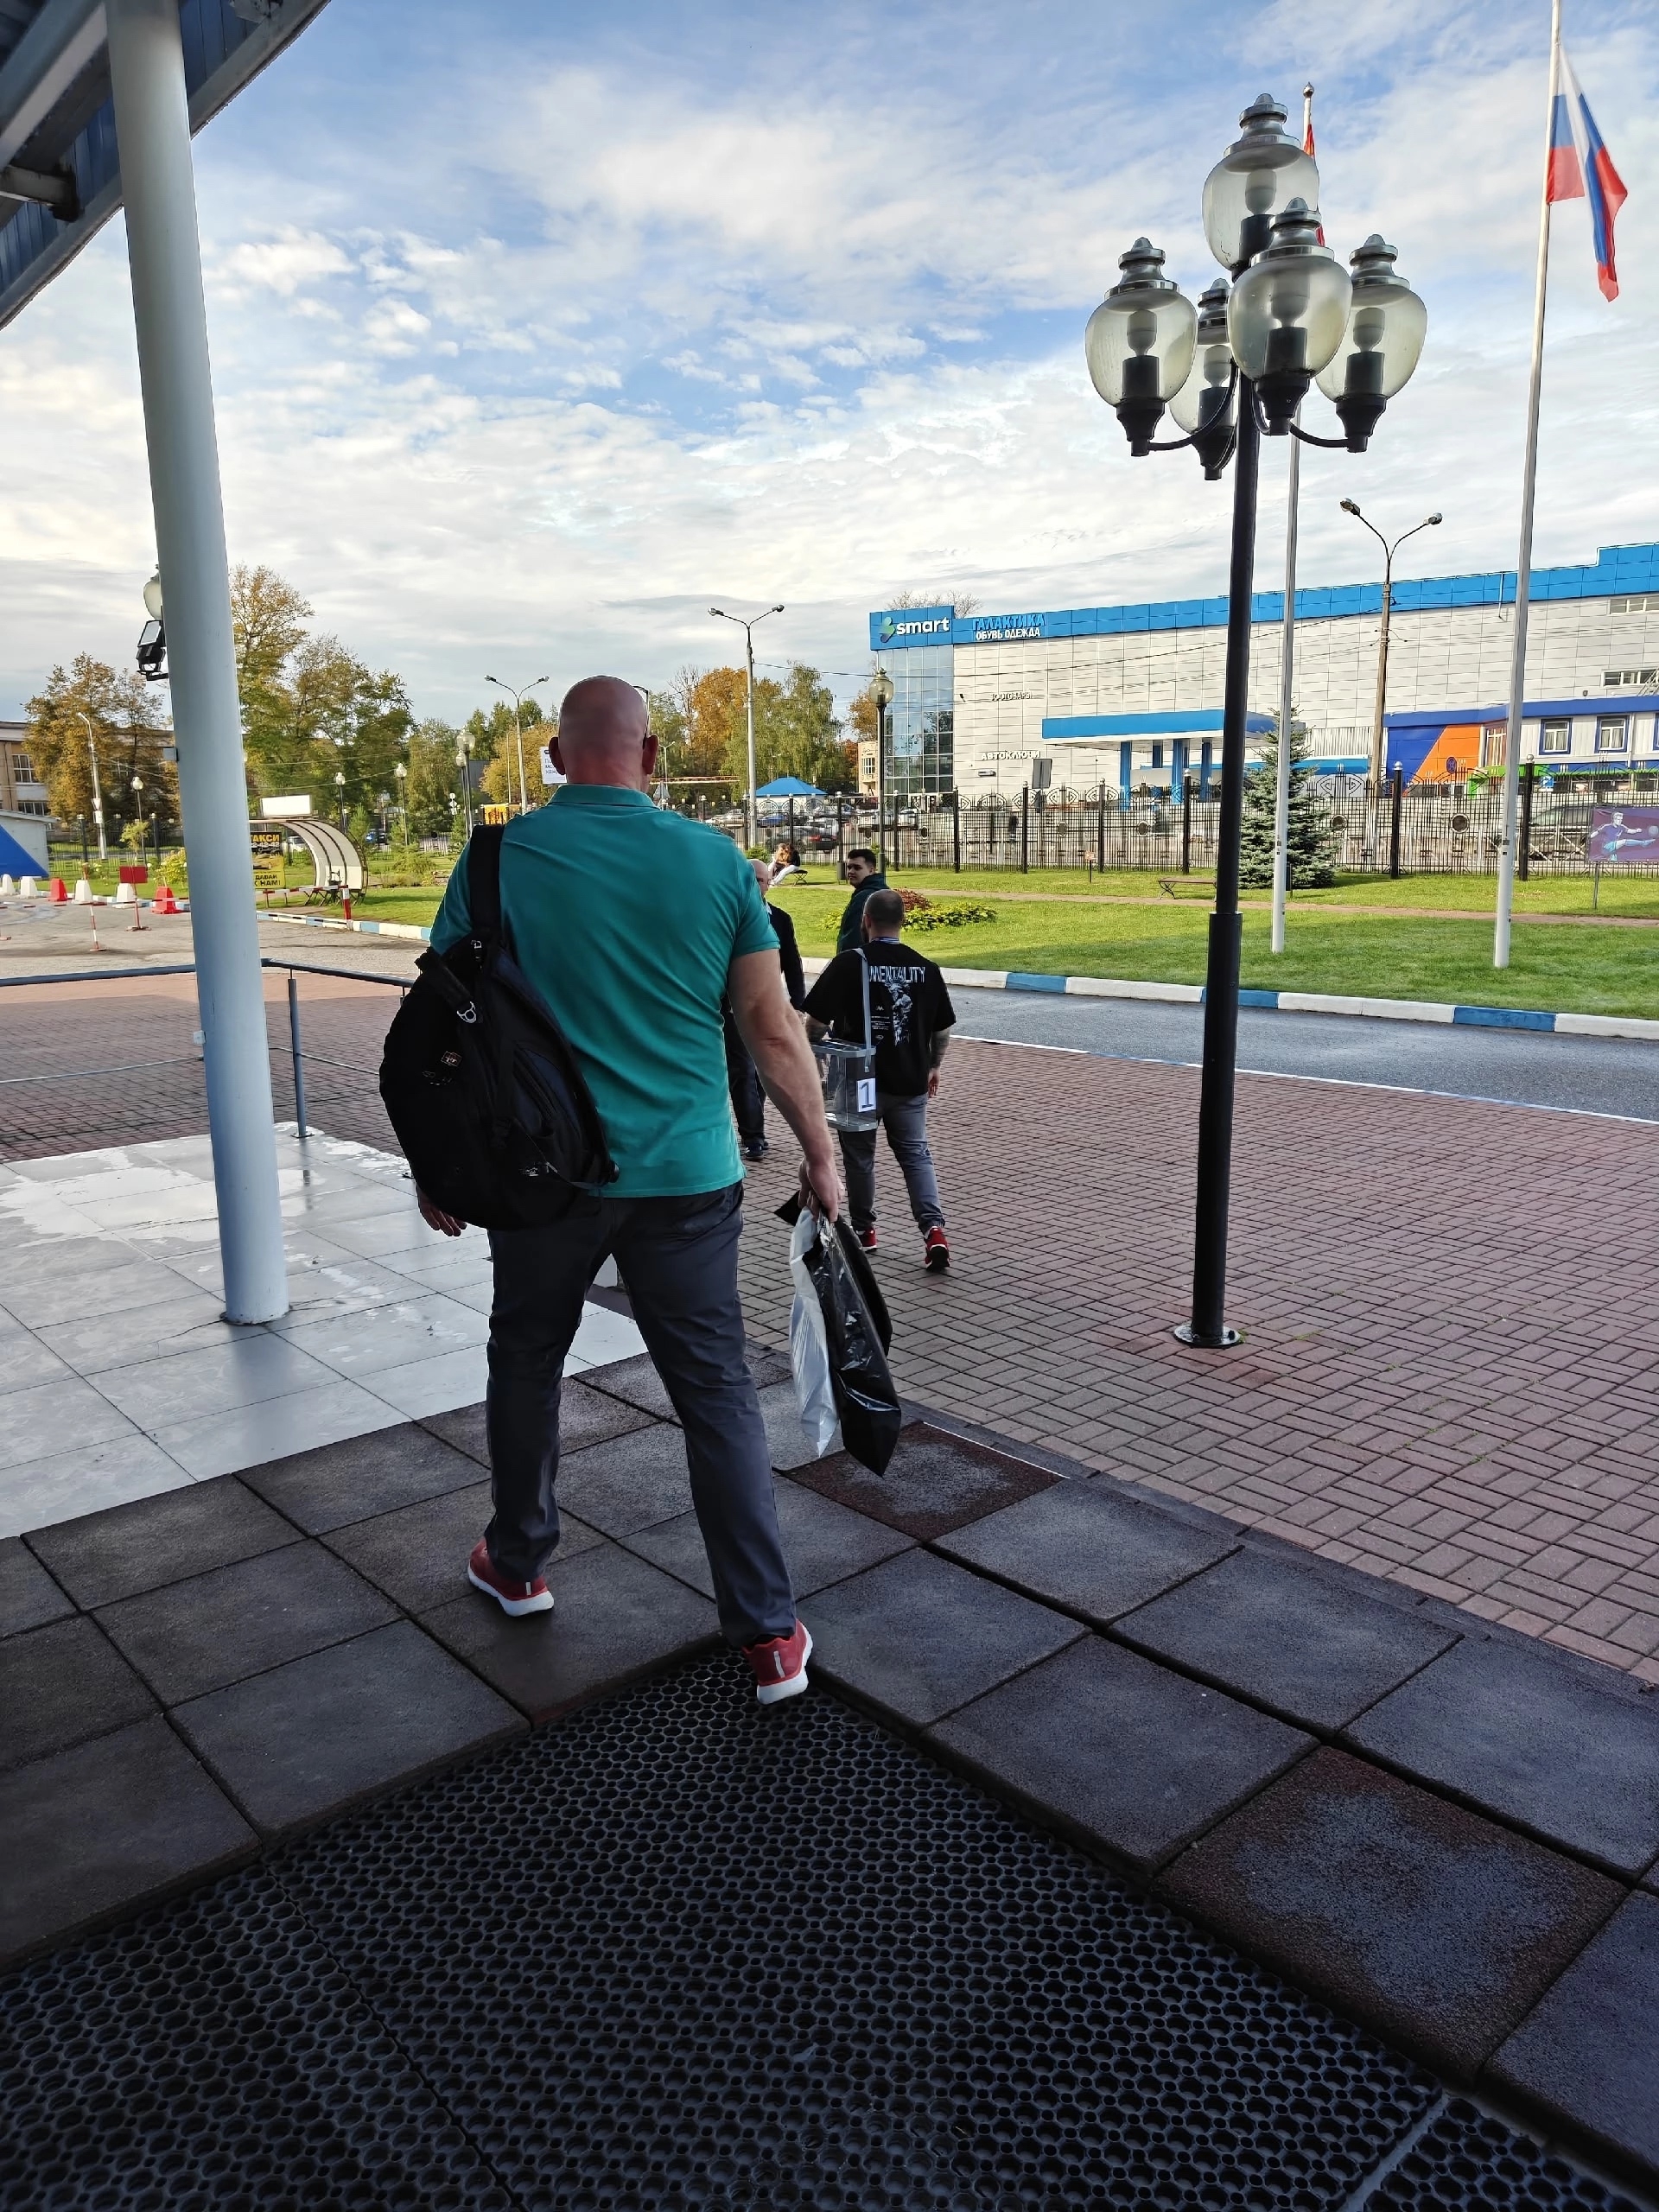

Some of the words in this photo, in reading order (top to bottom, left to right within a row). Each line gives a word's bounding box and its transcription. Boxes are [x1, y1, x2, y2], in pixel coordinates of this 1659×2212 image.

[896, 616, 950, 635] smart
[972, 613, 1046, 631] ГАЛАКТИКА
[976, 629, 1003, 641] ОБУВЬ
[1004, 627, 1041, 639] ОДЕЖДА
[981, 750, 1041, 760] АВТОКЛЮЧИ
[251, 834, 280, 842] АКСИ
[869, 965, 925, 983] MENTALITY
[861, 1081, 874, 1109] 1
